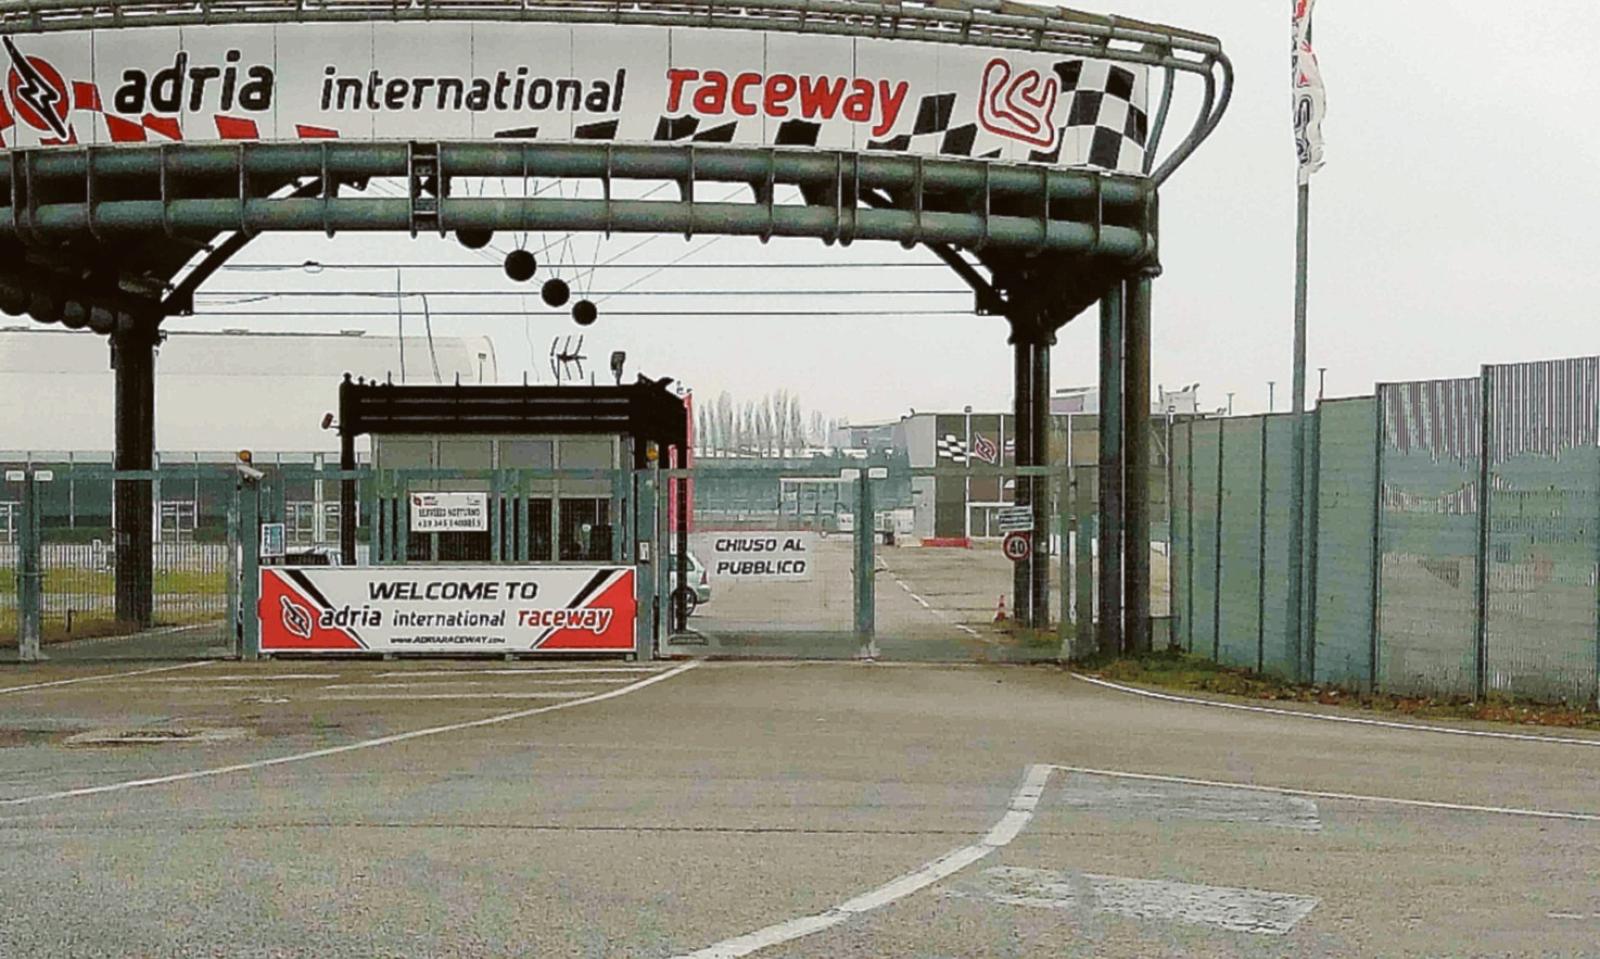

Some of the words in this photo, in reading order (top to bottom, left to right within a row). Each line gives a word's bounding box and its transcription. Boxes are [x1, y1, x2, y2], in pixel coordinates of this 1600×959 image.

[114, 50, 274, 114] adria
[320, 66, 626, 113] international
[667, 68, 909, 138] raceway
[715, 539, 777, 552] CHIUSO
[782, 539, 806, 552] AL
[1009, 540, 1025, 555] 40
[716, 560, 806, 575] PUBBLICO
[369, 582, 499, 600] WELCOME
[505, 582, 538, 600] TO
[320, 605, 382, 626] adria
[393, 609, 506, 627] international
[518, 609, 611, 632] raceway
